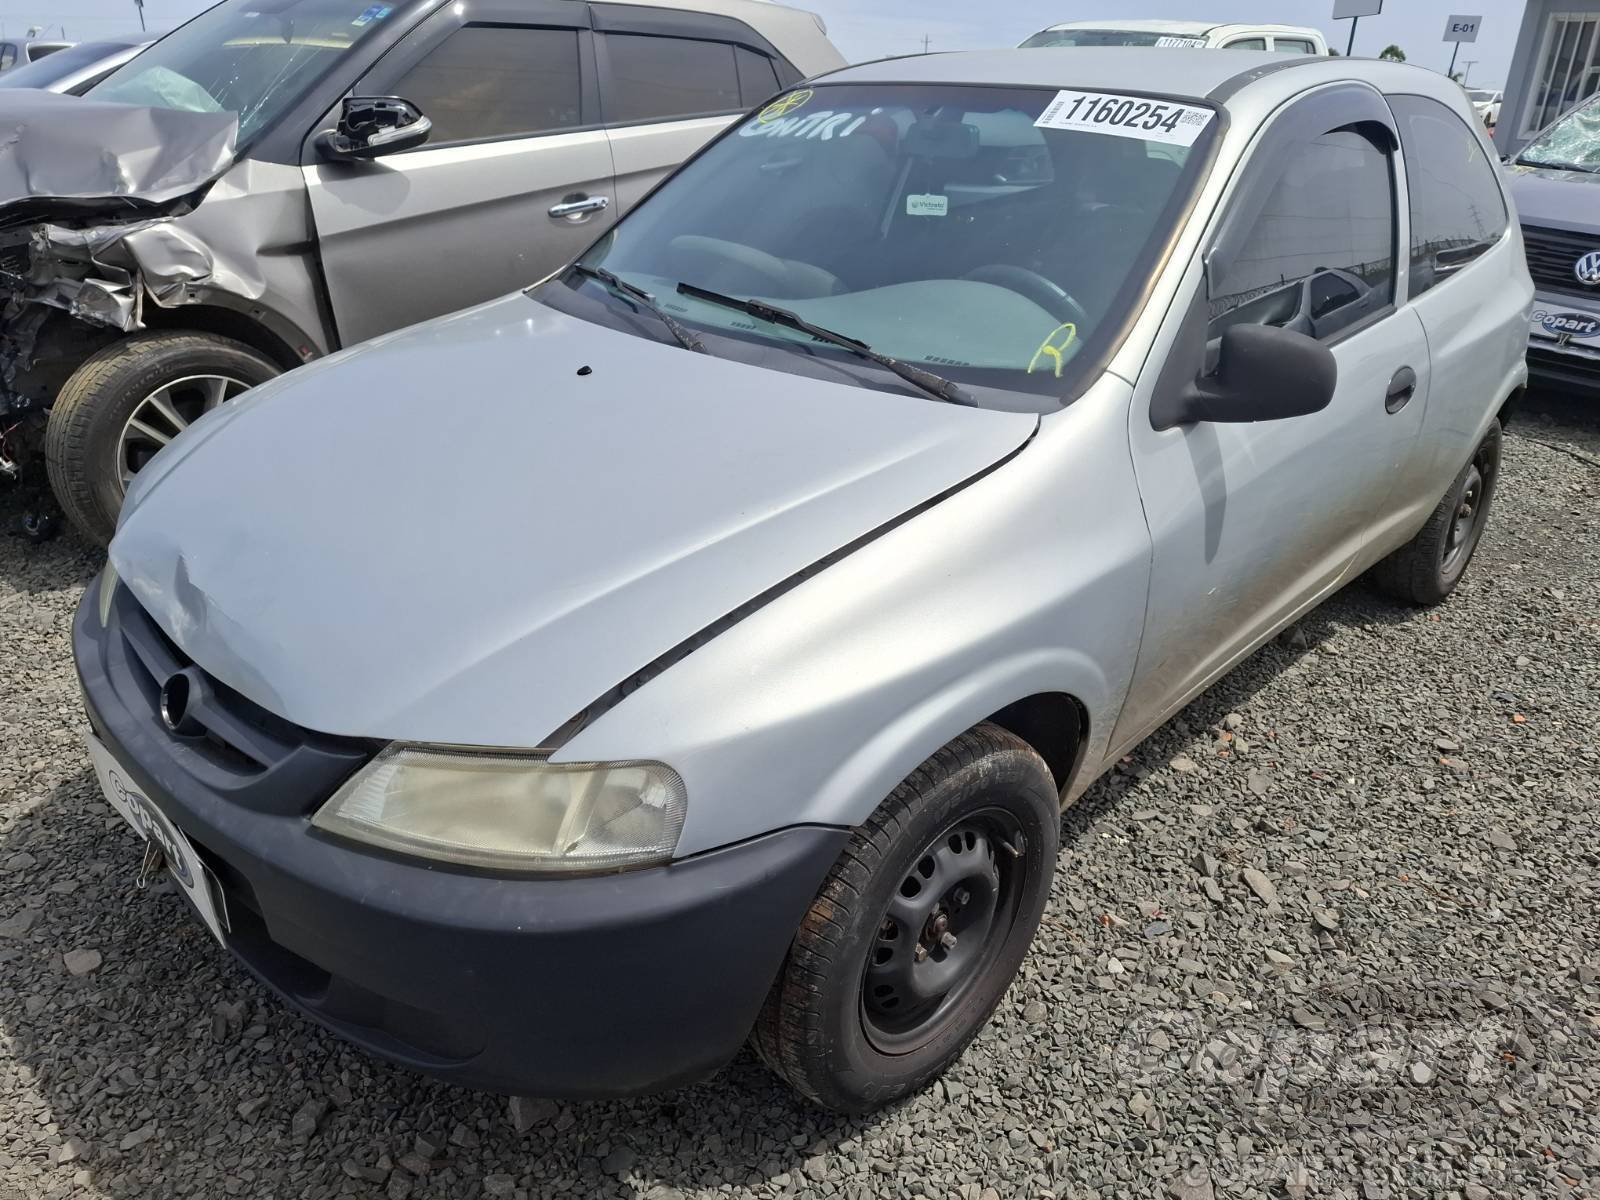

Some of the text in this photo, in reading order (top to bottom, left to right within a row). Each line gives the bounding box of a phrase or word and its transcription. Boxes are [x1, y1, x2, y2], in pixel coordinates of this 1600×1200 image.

[1452, 23, 1475, 32] E-01
[1065, 95, 1185, 133] 1160254
[1532, 309, 1596, 333] Copart
[109, 769, 184, 872] Copart
